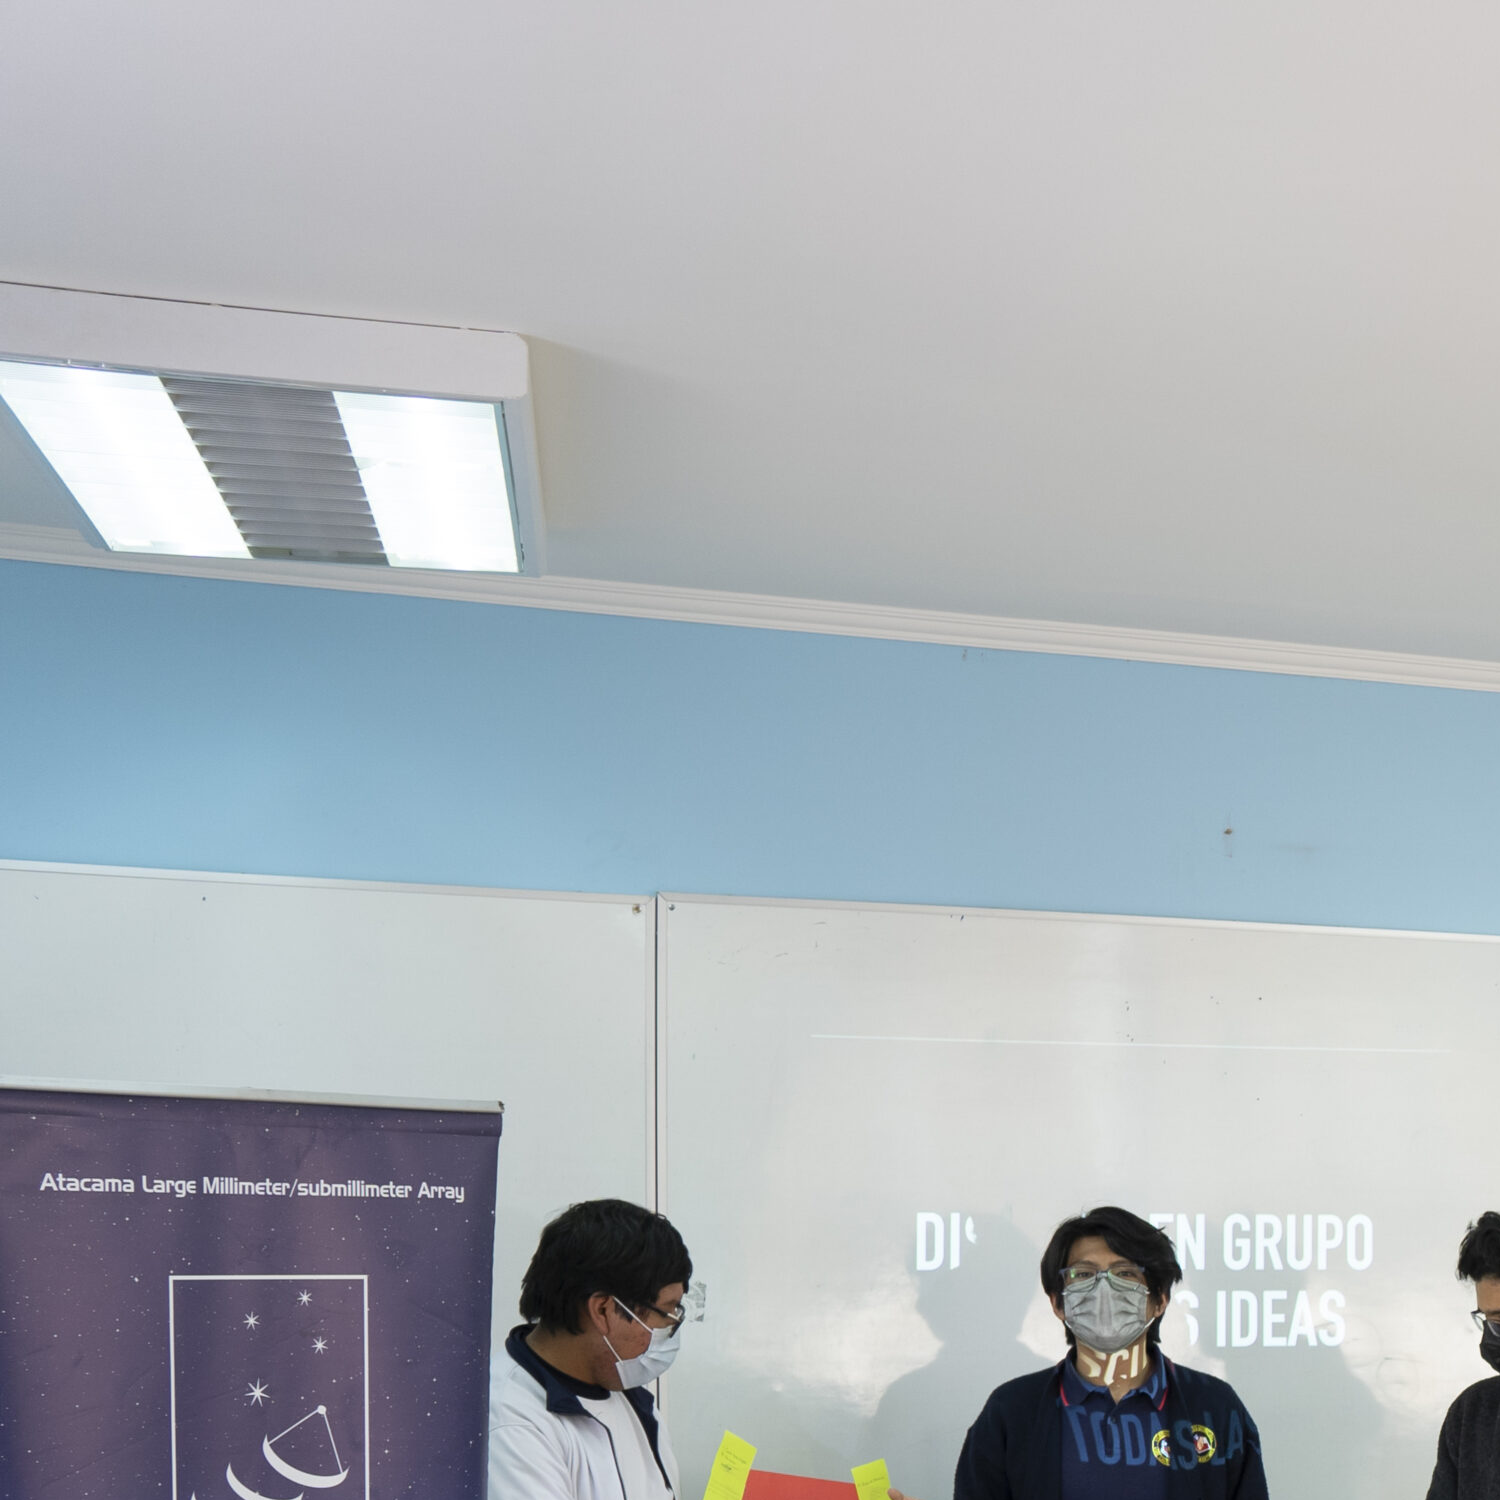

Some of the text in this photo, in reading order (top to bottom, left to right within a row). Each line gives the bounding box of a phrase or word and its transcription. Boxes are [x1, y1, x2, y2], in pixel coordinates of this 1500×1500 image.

[40, 1172, 466, 1204] Atacama Large Millimeter/submillimeter Array
[1222, 1212, 1375, 1272] GRUPO
[1215, 1288, 1347, 1348] IDEAS
[1064, 1404, 1198, 1471] TODAS
